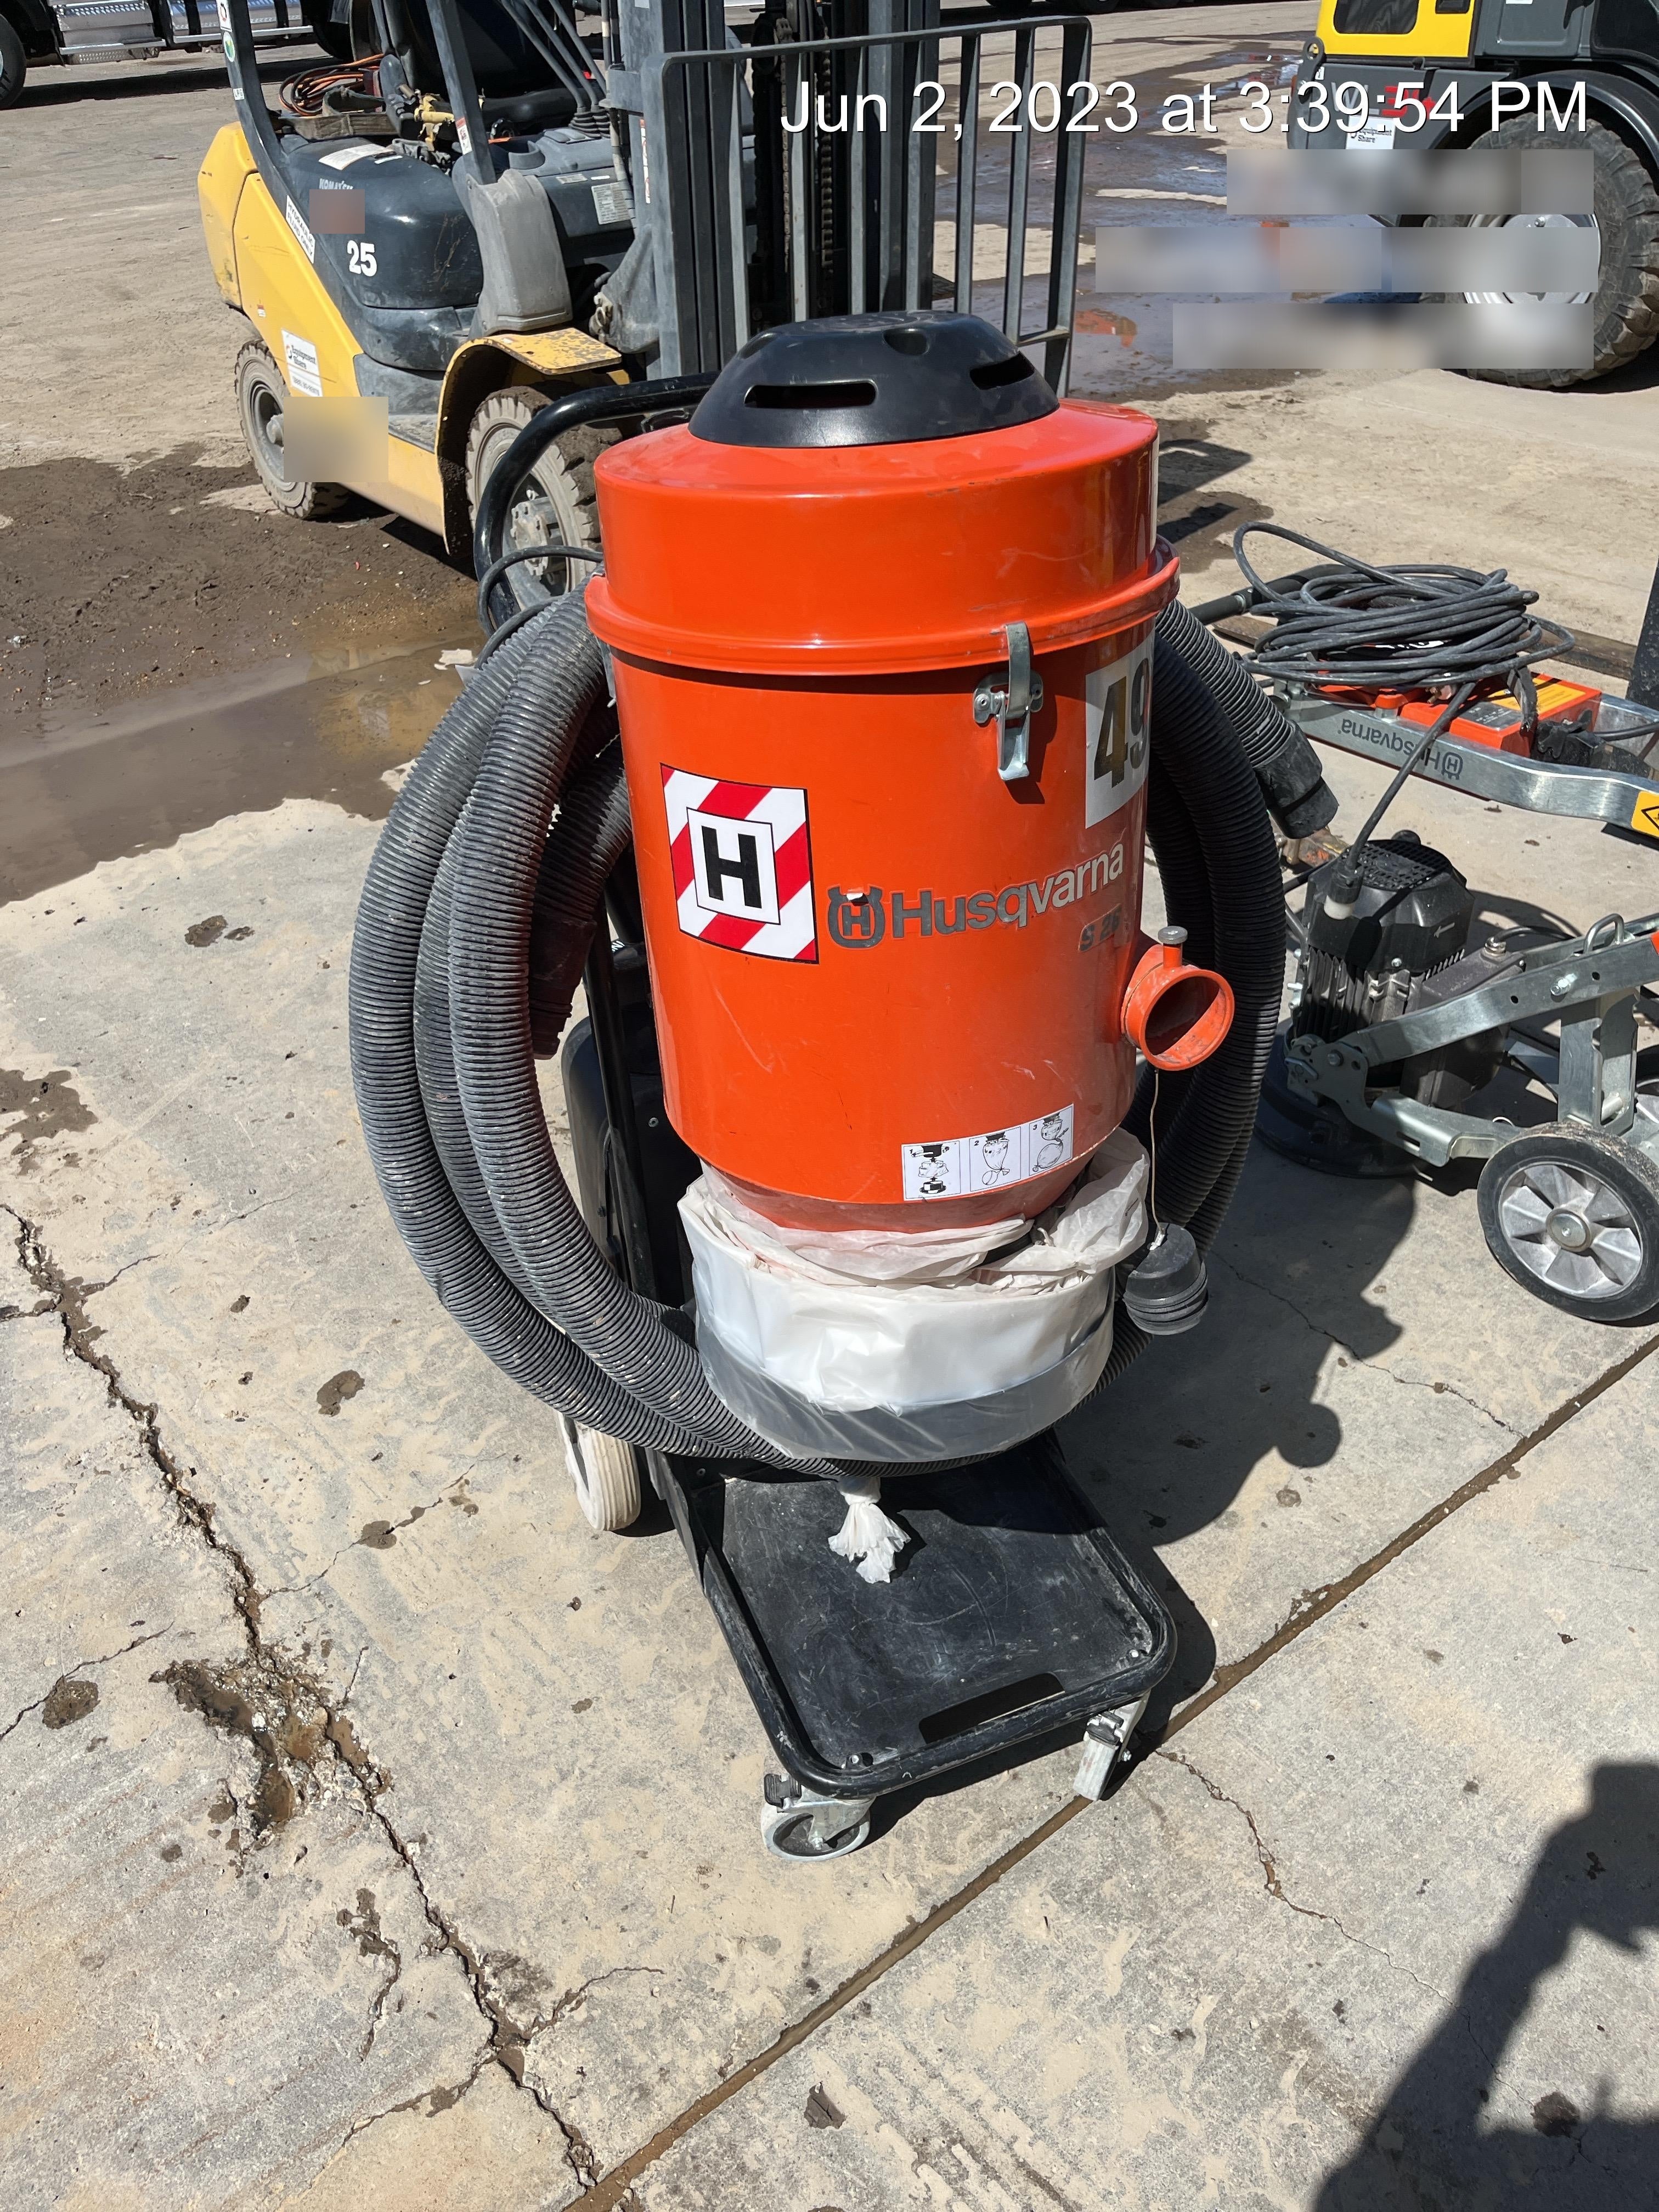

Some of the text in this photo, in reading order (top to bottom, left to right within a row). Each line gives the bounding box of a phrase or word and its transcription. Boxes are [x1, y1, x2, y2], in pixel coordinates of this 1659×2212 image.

[347, 240, 377, 276] 25
[1094, 658, 1150, 789] 49
[701, 825, 762, 909] H
[891, 843, 1124, 939] Husqvarna
